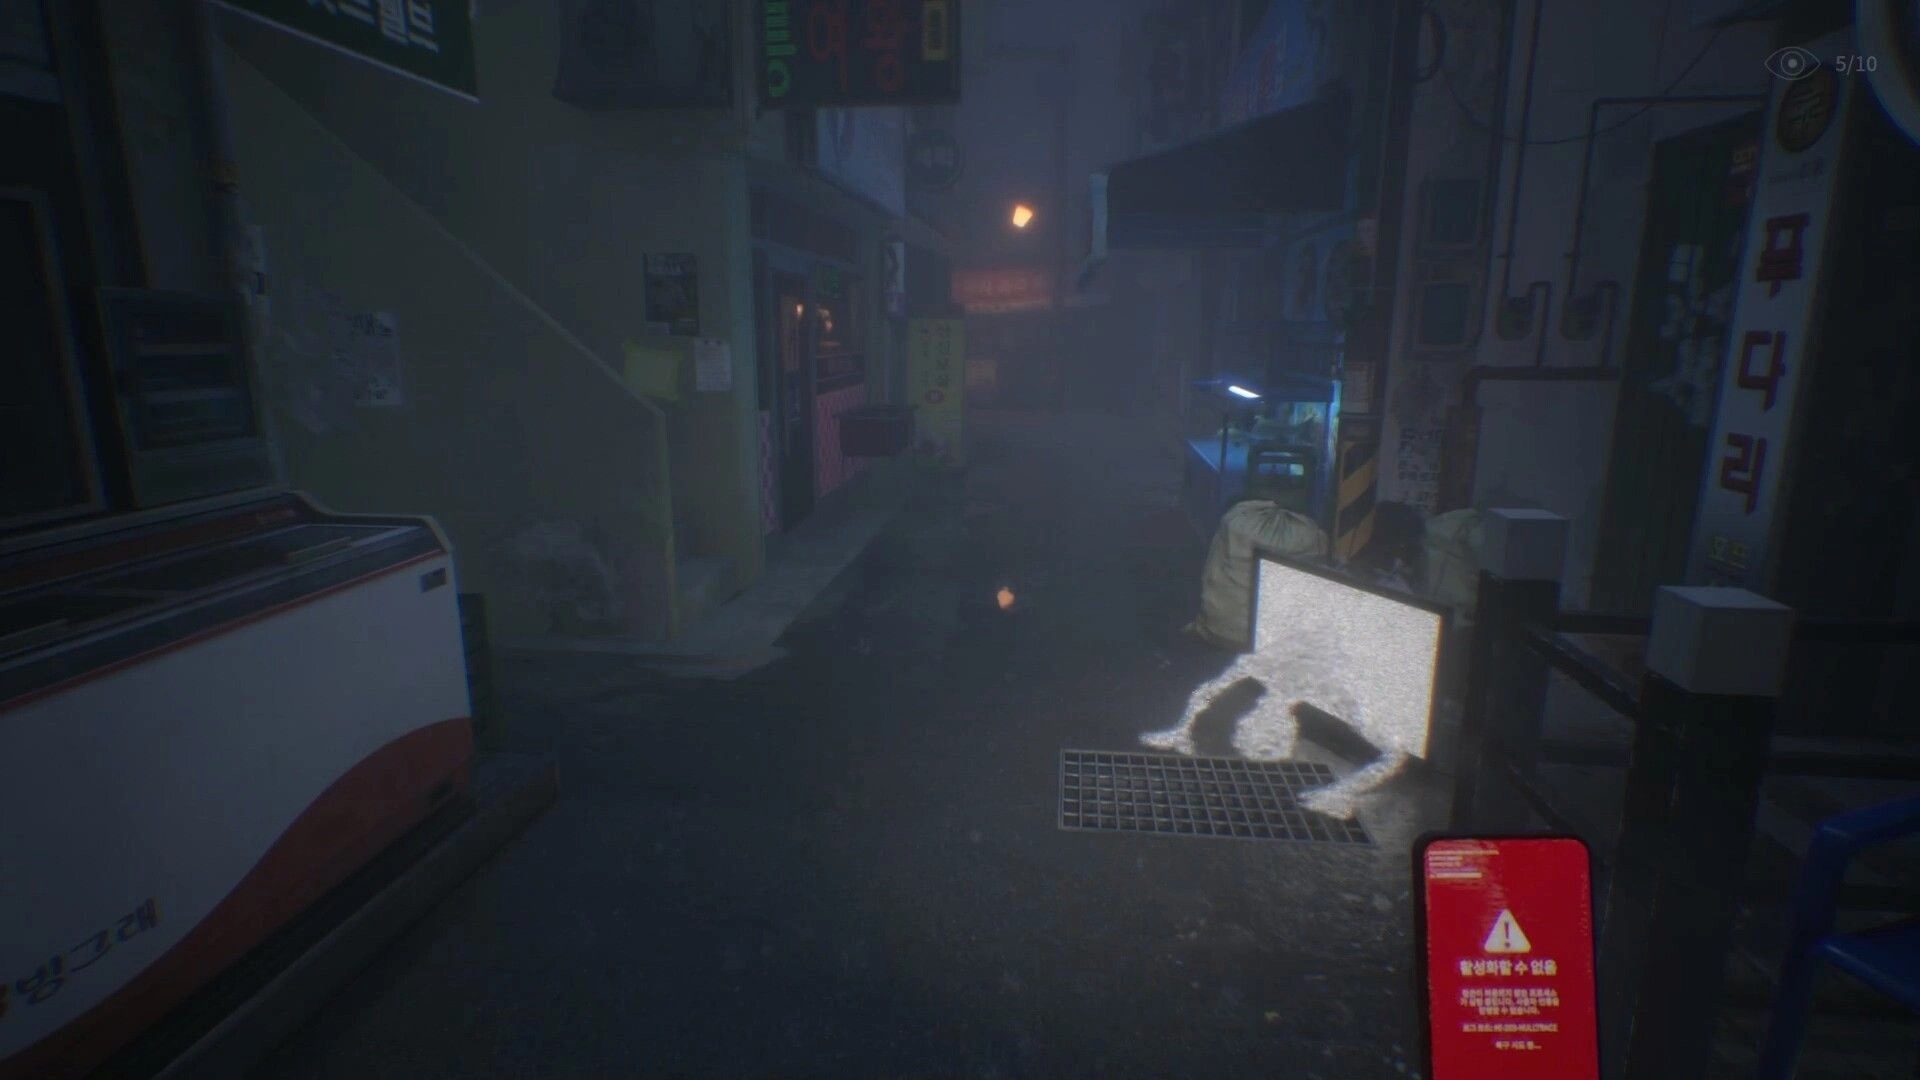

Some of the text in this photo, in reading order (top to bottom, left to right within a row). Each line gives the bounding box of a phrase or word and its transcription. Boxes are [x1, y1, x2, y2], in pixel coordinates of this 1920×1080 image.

[1460, 959, 1557, 976] 활성화할 수 없음
